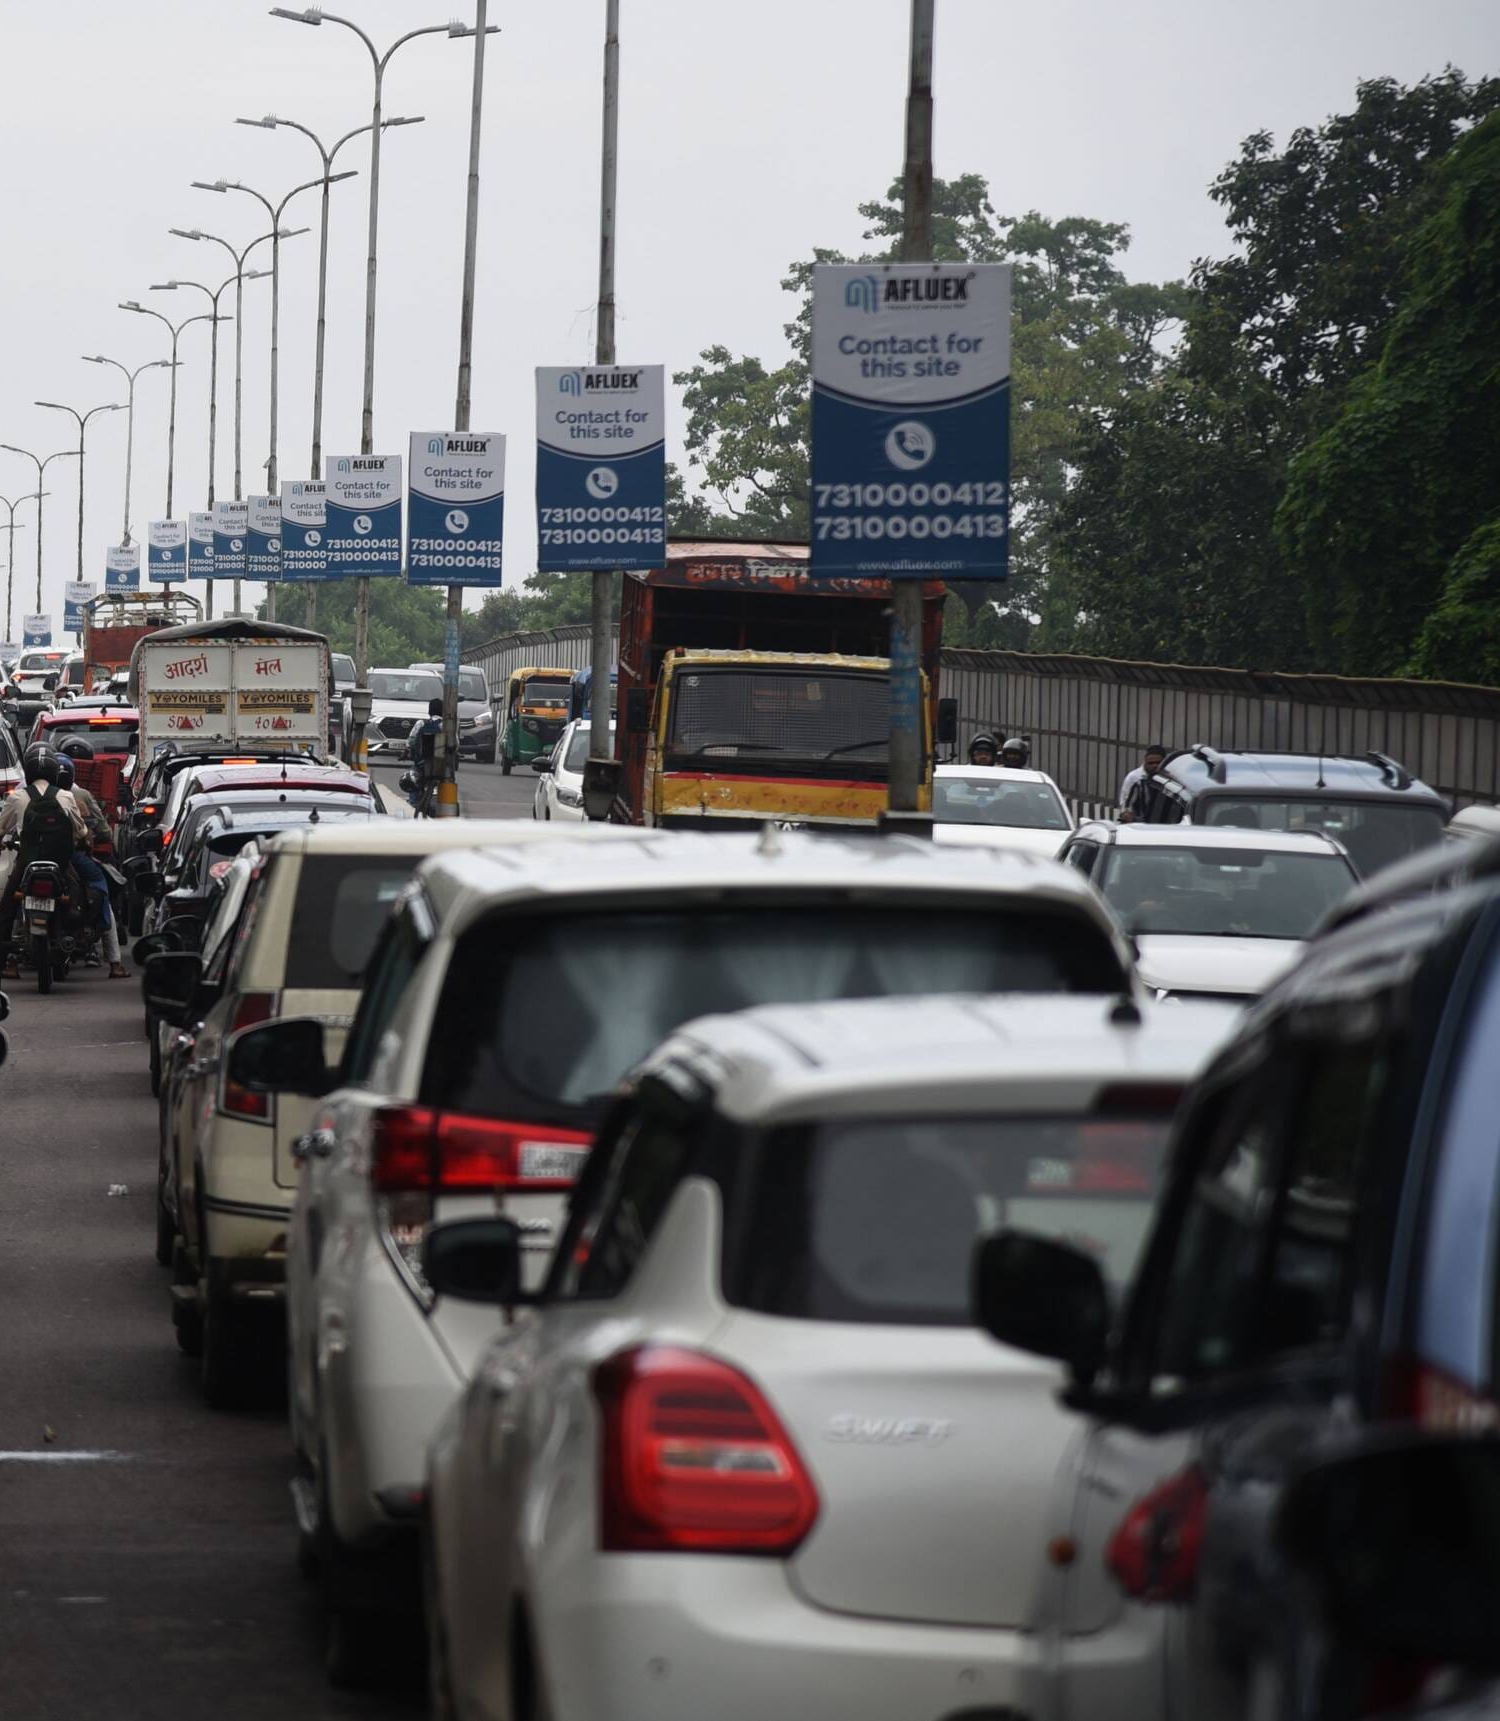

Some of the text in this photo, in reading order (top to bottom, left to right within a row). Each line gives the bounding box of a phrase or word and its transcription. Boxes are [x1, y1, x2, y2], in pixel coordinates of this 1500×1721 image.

[884, 277, 968, 302] AFLUEX
[838, 331, 983, 355] Contact for
[860, 356, 961, 378] this site
[584, 373, 639, 389] AFLUEX
[555, 409, 649, 424] Contact for
[570, 425, 634, 439] this site
[446, 440, 487, 453] AFLUEX
[352, 460, 385, 470] AFLUEX
[424, 466, 494, 479] Contact for
[304, 484, 326, 493] AFLUE
[335, 480, 390, 490] Contact for
[435, 478, 483, 489] this site
[344, 490, 382, 499] this site
[814, 482, 1005, 507] 7310000412
[290, 502, 322, 511] Contact
[540, 507, 664, 523] 7310000412
[814, 514, 1005, 540] 7310000413
[540, 528, 664, 544] 7310000413
[327, 539, 399, 549] 7310000412
[410, 538, 501, 552] 7310000412
[248, 555, 280, 563] 731000
[283, 551, 327, 559] 7310000
[327, 551, 399, 561] 7310000413
[410, 554, 501, 568] 7310000413
[248, 564, 280, 572] 731000
[283, 561, 327, 569] 7310000
